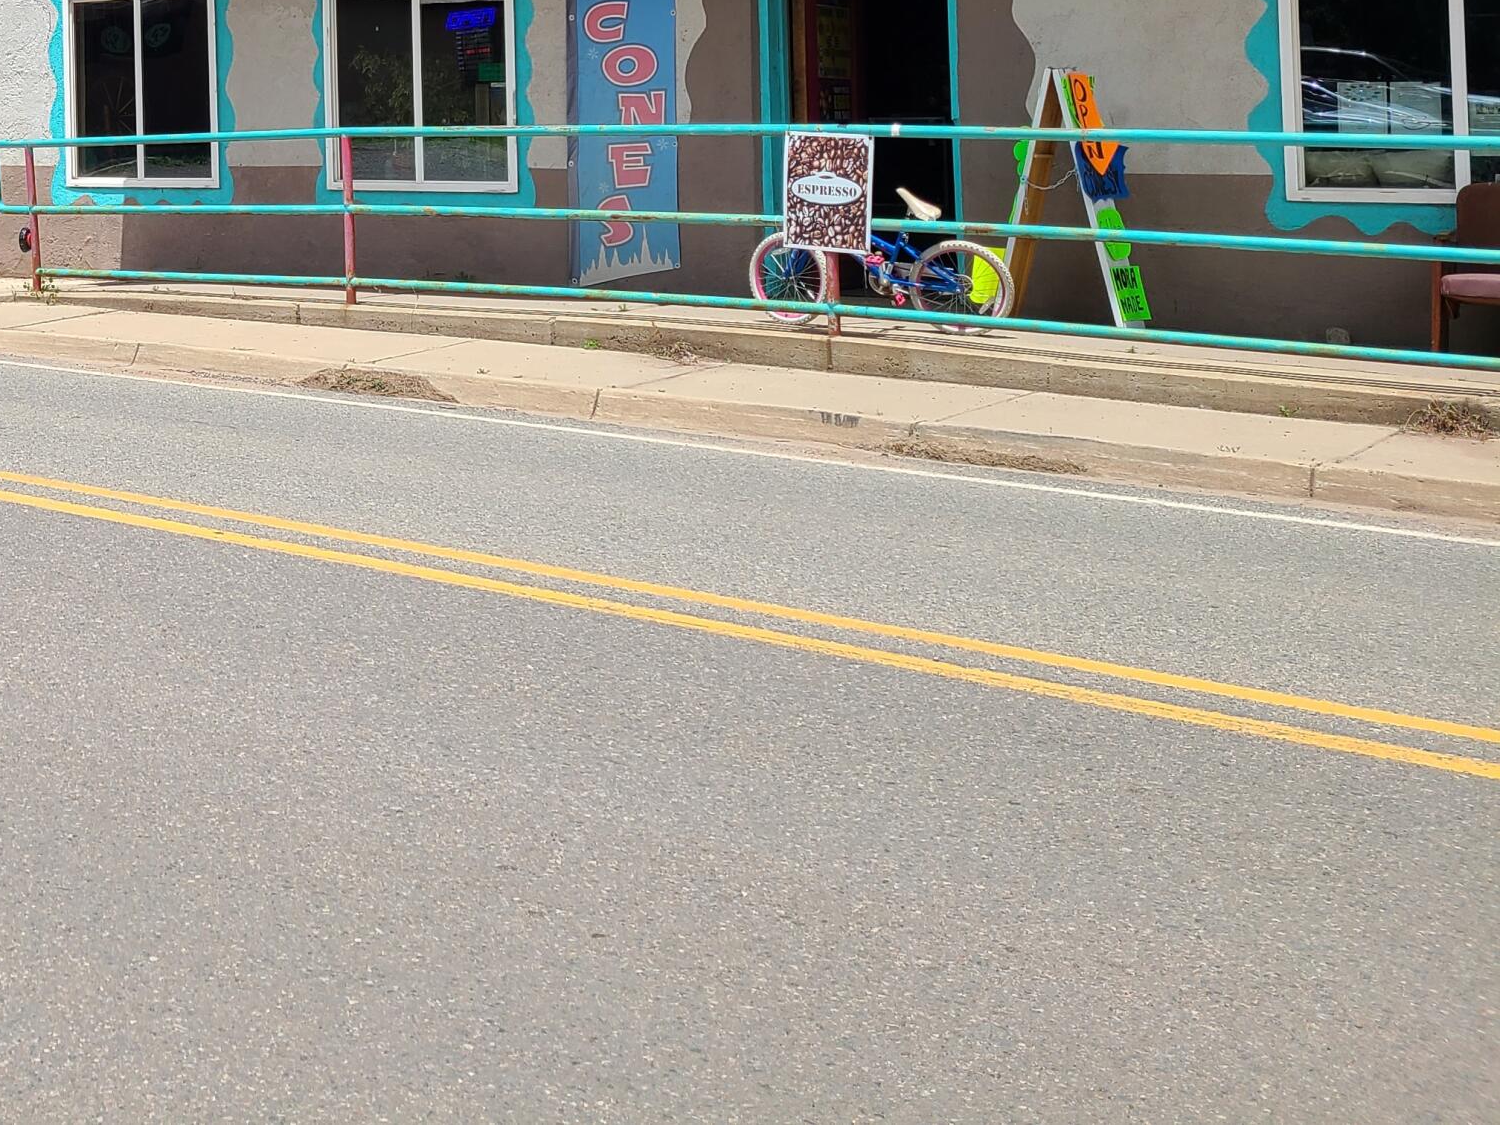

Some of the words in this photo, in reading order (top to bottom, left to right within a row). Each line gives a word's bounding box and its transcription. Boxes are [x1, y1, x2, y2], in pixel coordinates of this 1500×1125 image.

[583, 0, 667, 249] CONES
[1073, 78, 1106, 160] OPN
[797, 183, 858, 198] ESPRESSO
[1112, 267, 1138, 292] MORA
[1120, 295, 1145, 315] MADE
